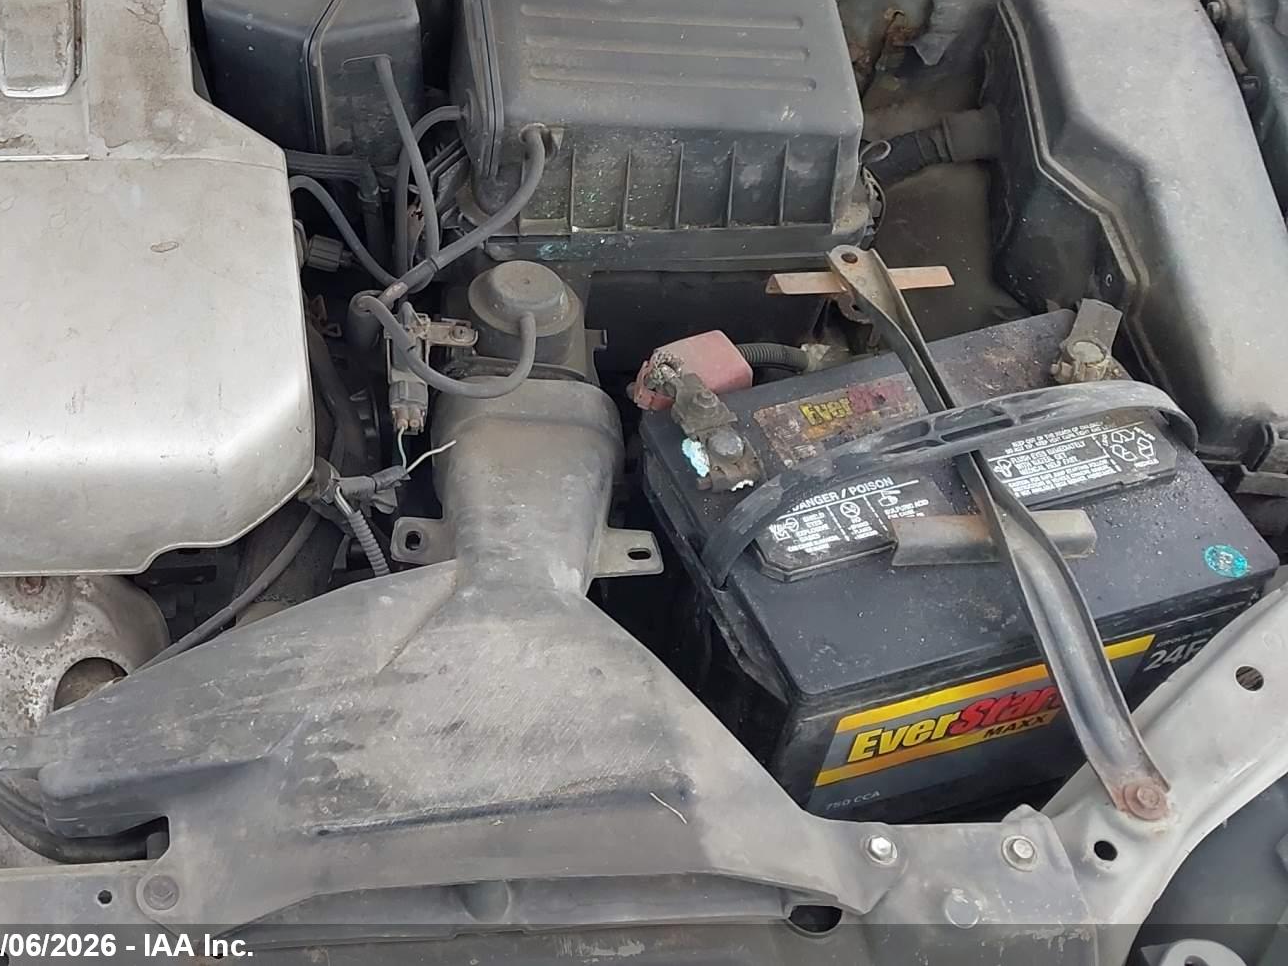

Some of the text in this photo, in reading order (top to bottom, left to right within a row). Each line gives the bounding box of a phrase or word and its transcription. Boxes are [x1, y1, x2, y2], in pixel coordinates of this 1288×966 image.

[848, 477, 895, 495] POISON
[983, 712, 1049, 739] MAXX
[853, 789, 881, 804] CCA
